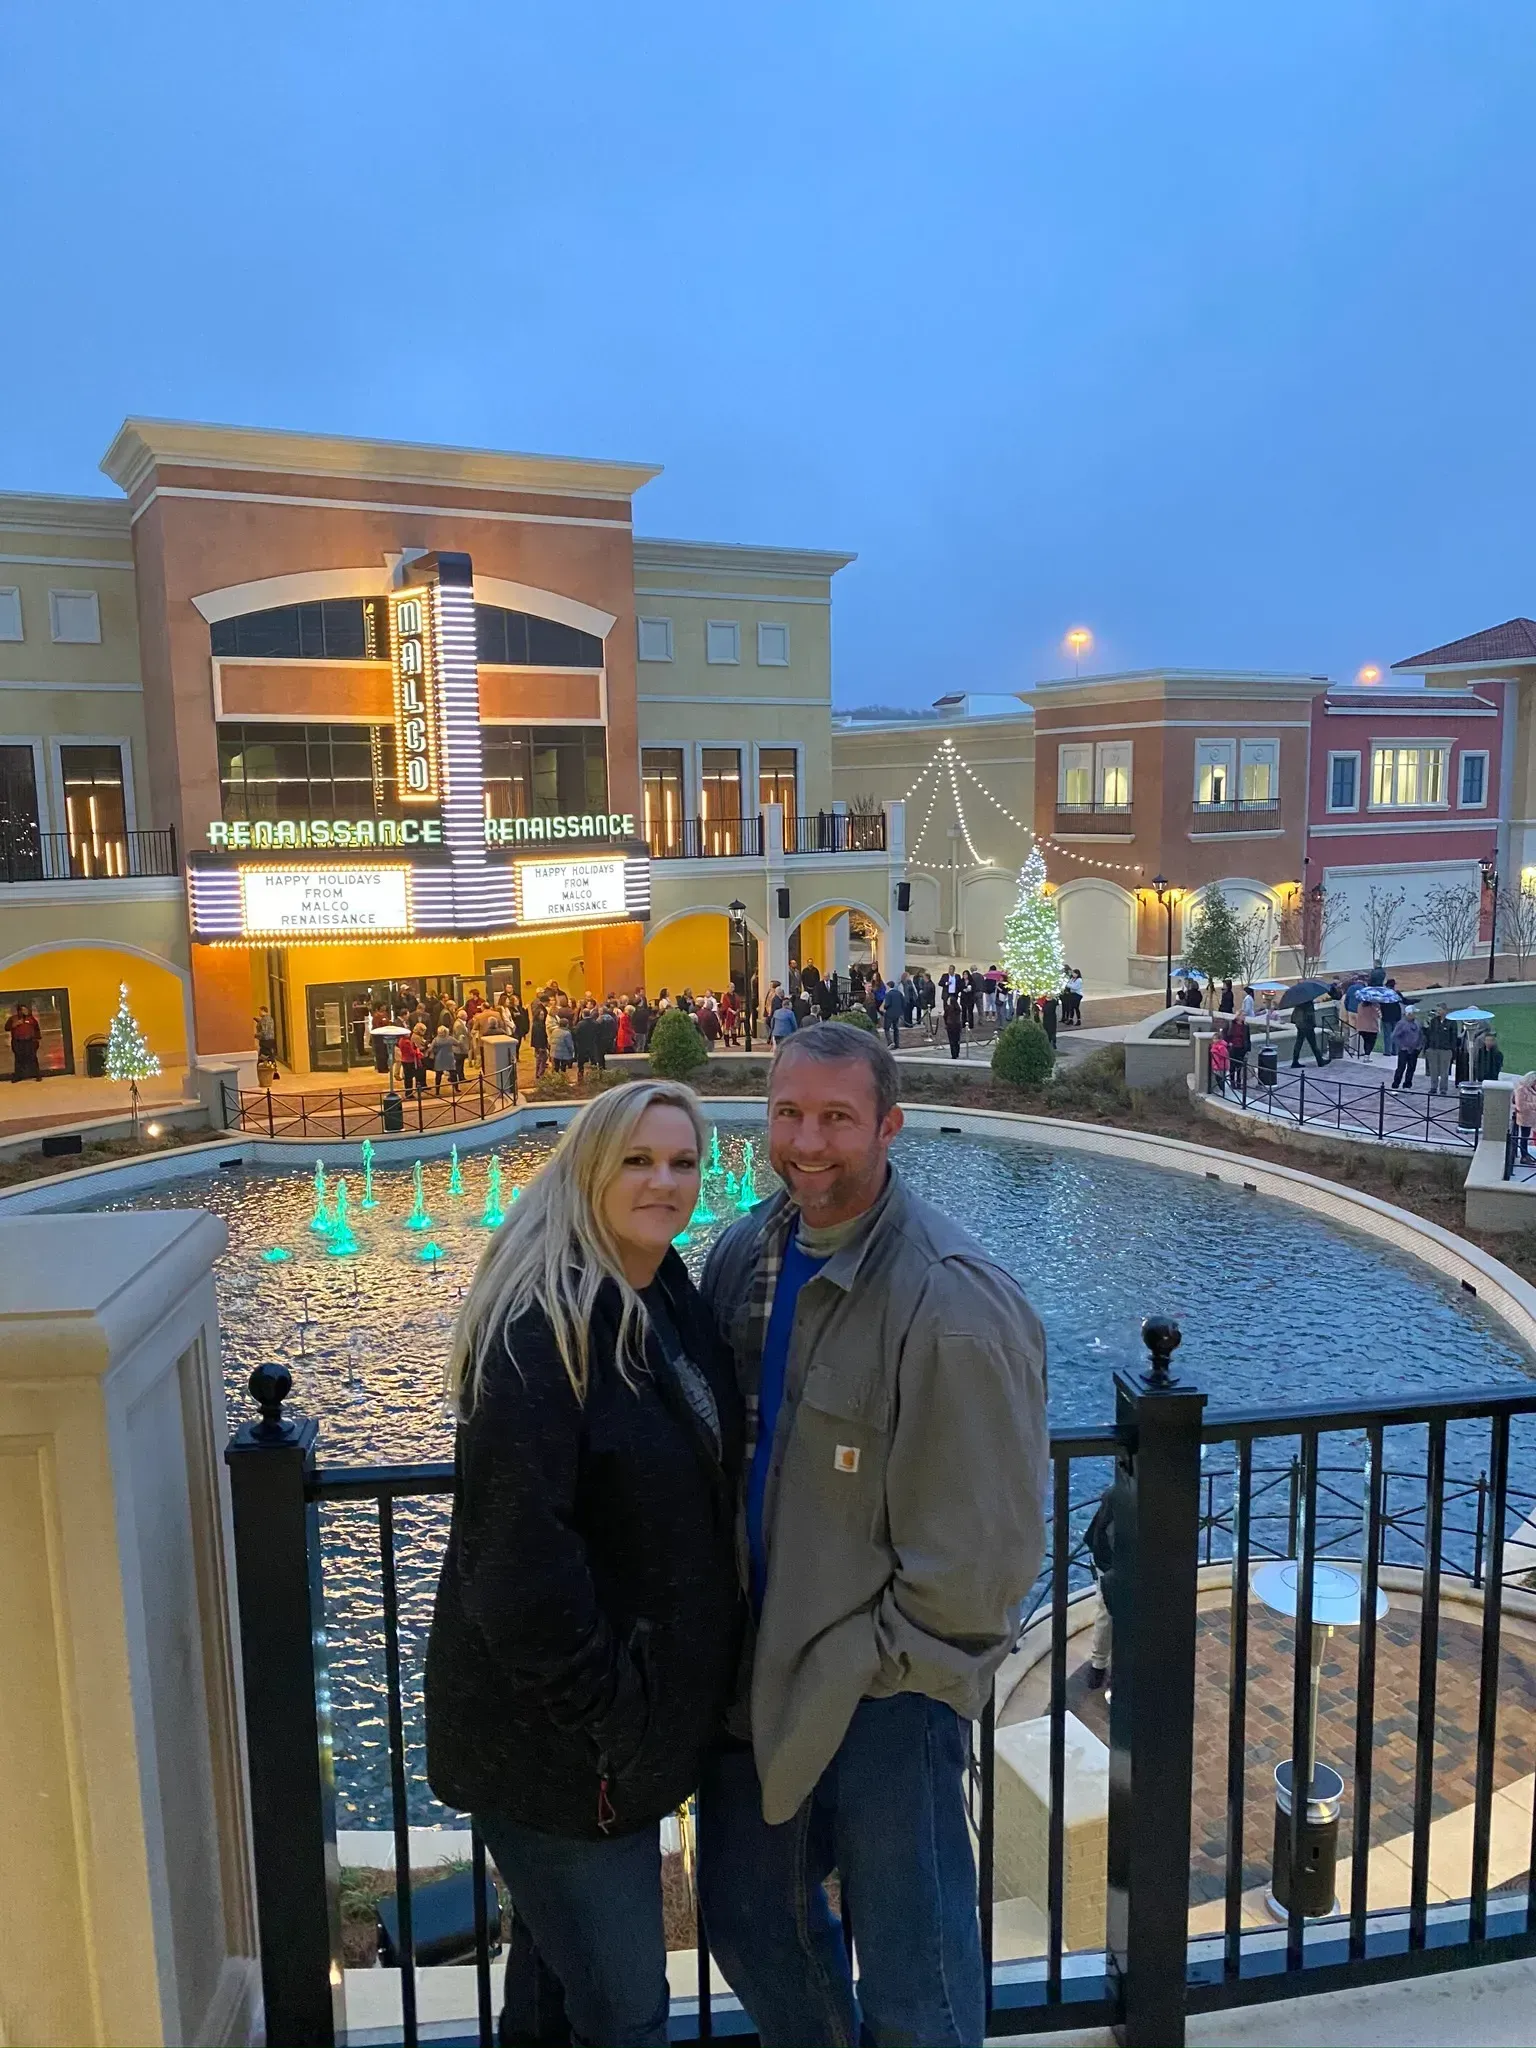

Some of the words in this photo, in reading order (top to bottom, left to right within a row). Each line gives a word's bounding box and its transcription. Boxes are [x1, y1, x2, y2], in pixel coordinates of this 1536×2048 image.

[397, 599, 430, 791] MALCO
[206, 819, 442, 845] RENAISSANCE
[484, 813, 635, 841] RENAISSANCE
[535, 867, 567, 878] HAPPY
[572, 864, 615, 876] HOLIDAYS
[265, 875, 311, 886] HAPPY
[318, 874, 381, 885] HOLIDAYS
[564, 878, 590, 888] FROM
[304, 888, 343, 898] FROM
[562, 889, 592, 900] MALCO
[301, 901, 349, 911] MALCO
[548, 900, 608, 914] RENAISSANCE
[281, 913, 376, 925] RENAISSANCE
